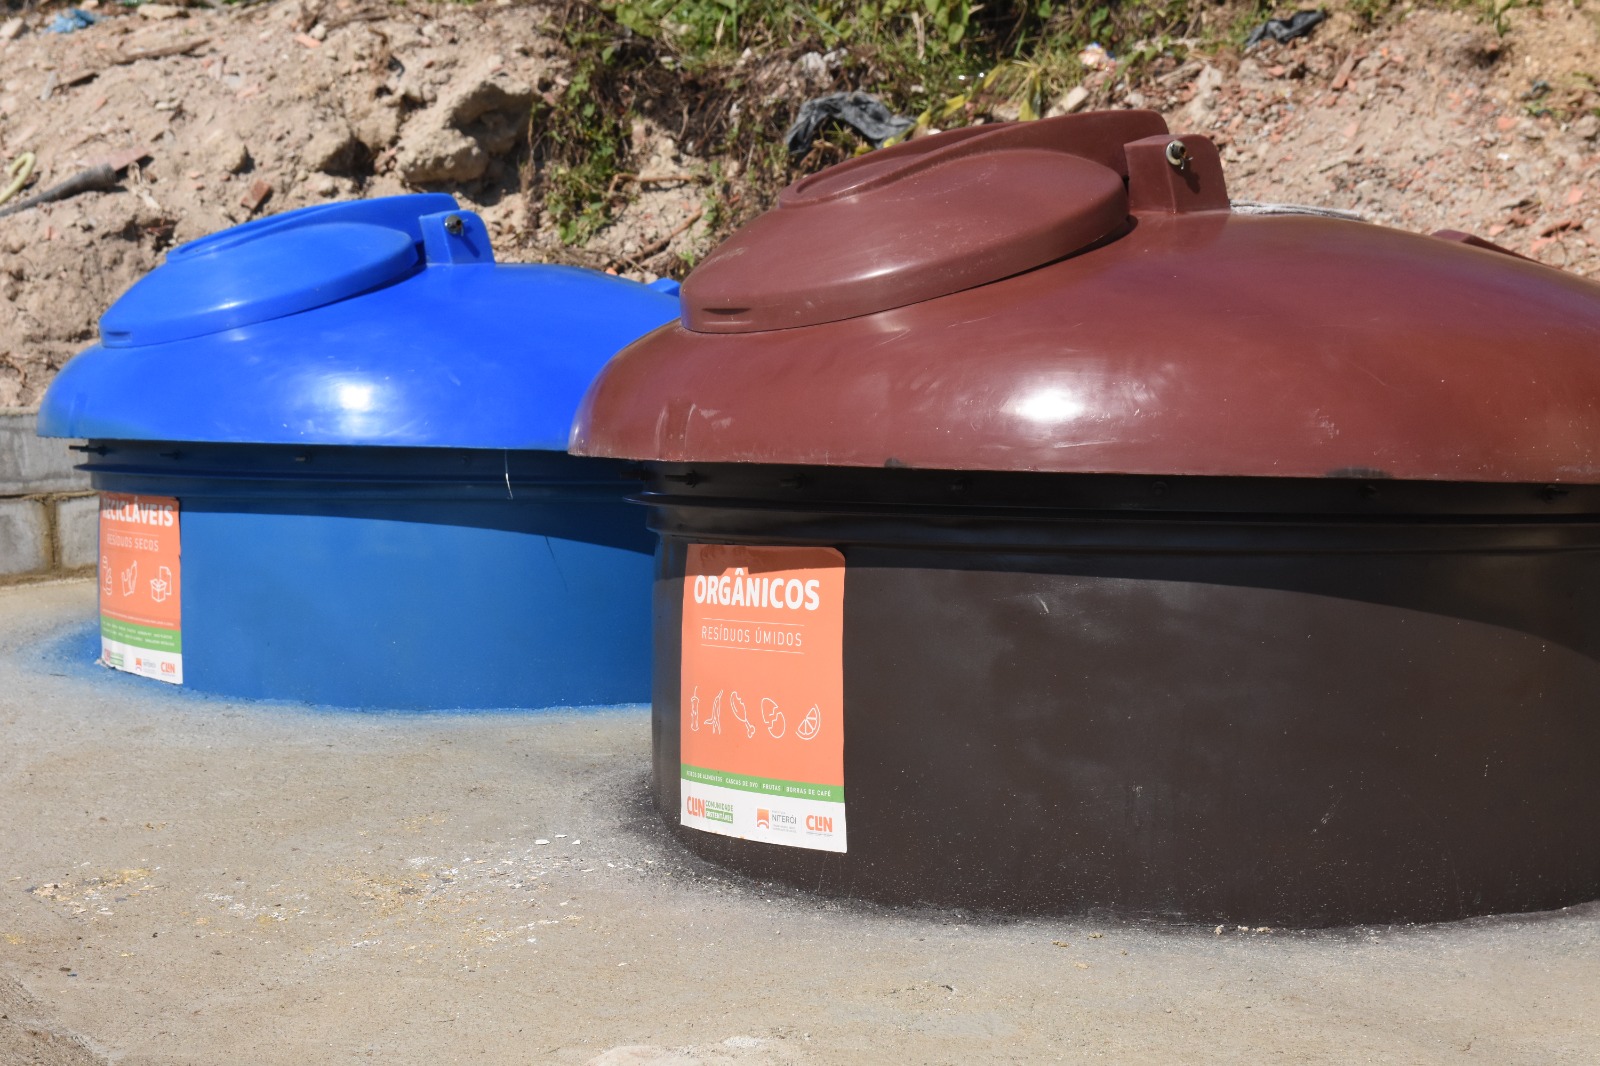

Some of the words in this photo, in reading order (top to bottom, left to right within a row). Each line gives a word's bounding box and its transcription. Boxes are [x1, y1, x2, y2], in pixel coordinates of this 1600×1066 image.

[134, 537, 159, 553] SECOS
[694, 567, 819, 611] ORGÂNICOS
[701, 624, 750, 643] RESÍDUOS
[755, 627, 802, 647] ÚMIDOS
[726, 778, 741, 786] CASCAS
[762, 783, 780, 791] FRUTAS
[786, 786, 806, 795] BORRAS
[816, 789, 831, 797] CAFÉ
[687, 796, 705, 818] CLIN
[772, 814, 797, 825] NITERÓI
[805, 814, 833, 832] CLIN
